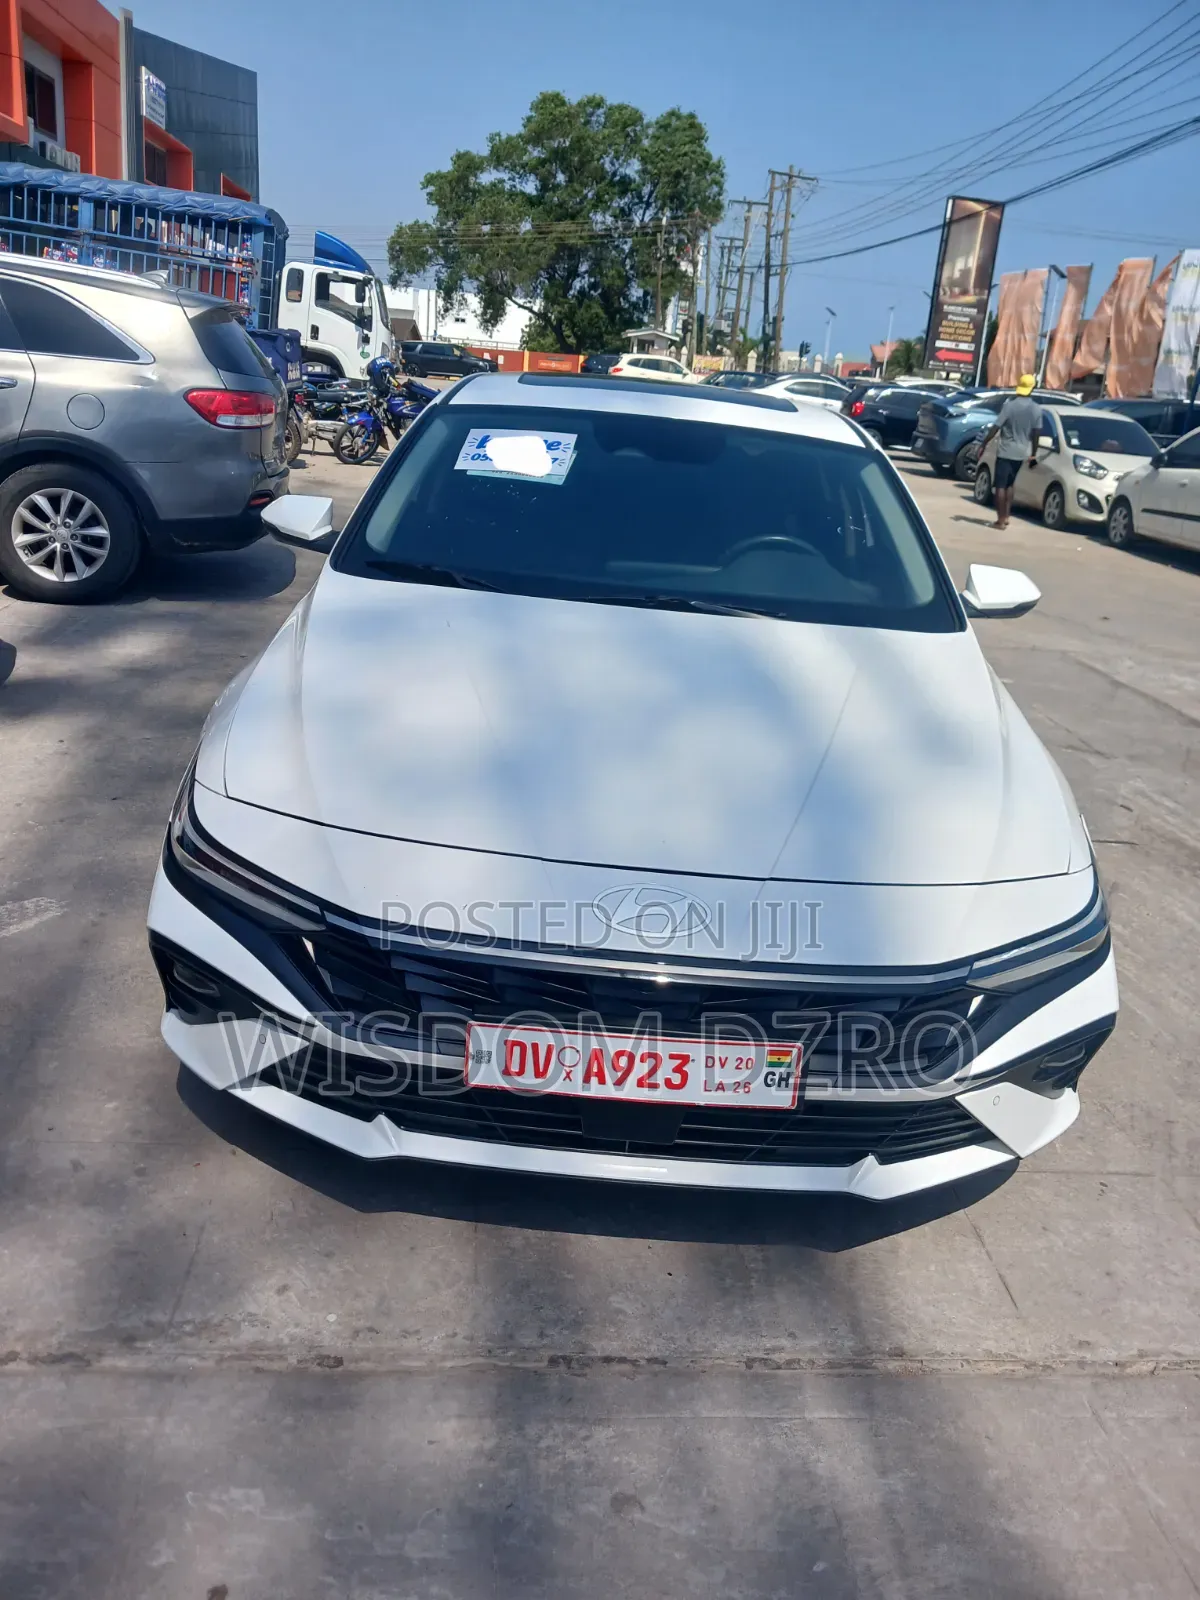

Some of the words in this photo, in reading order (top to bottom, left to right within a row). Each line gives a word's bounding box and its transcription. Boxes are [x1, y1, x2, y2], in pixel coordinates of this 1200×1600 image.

[502, 1039, 554, 1079] DV
[582, 1047, 691, 1090] A923
[704, 1056, 726, 1069] DV
[735, 1056, 754, 1070] 20
[704, 1080, 726, 1093] LA
[733, 1080, 752, 1094] 26
[763, 1070, 790, 1089] GH
